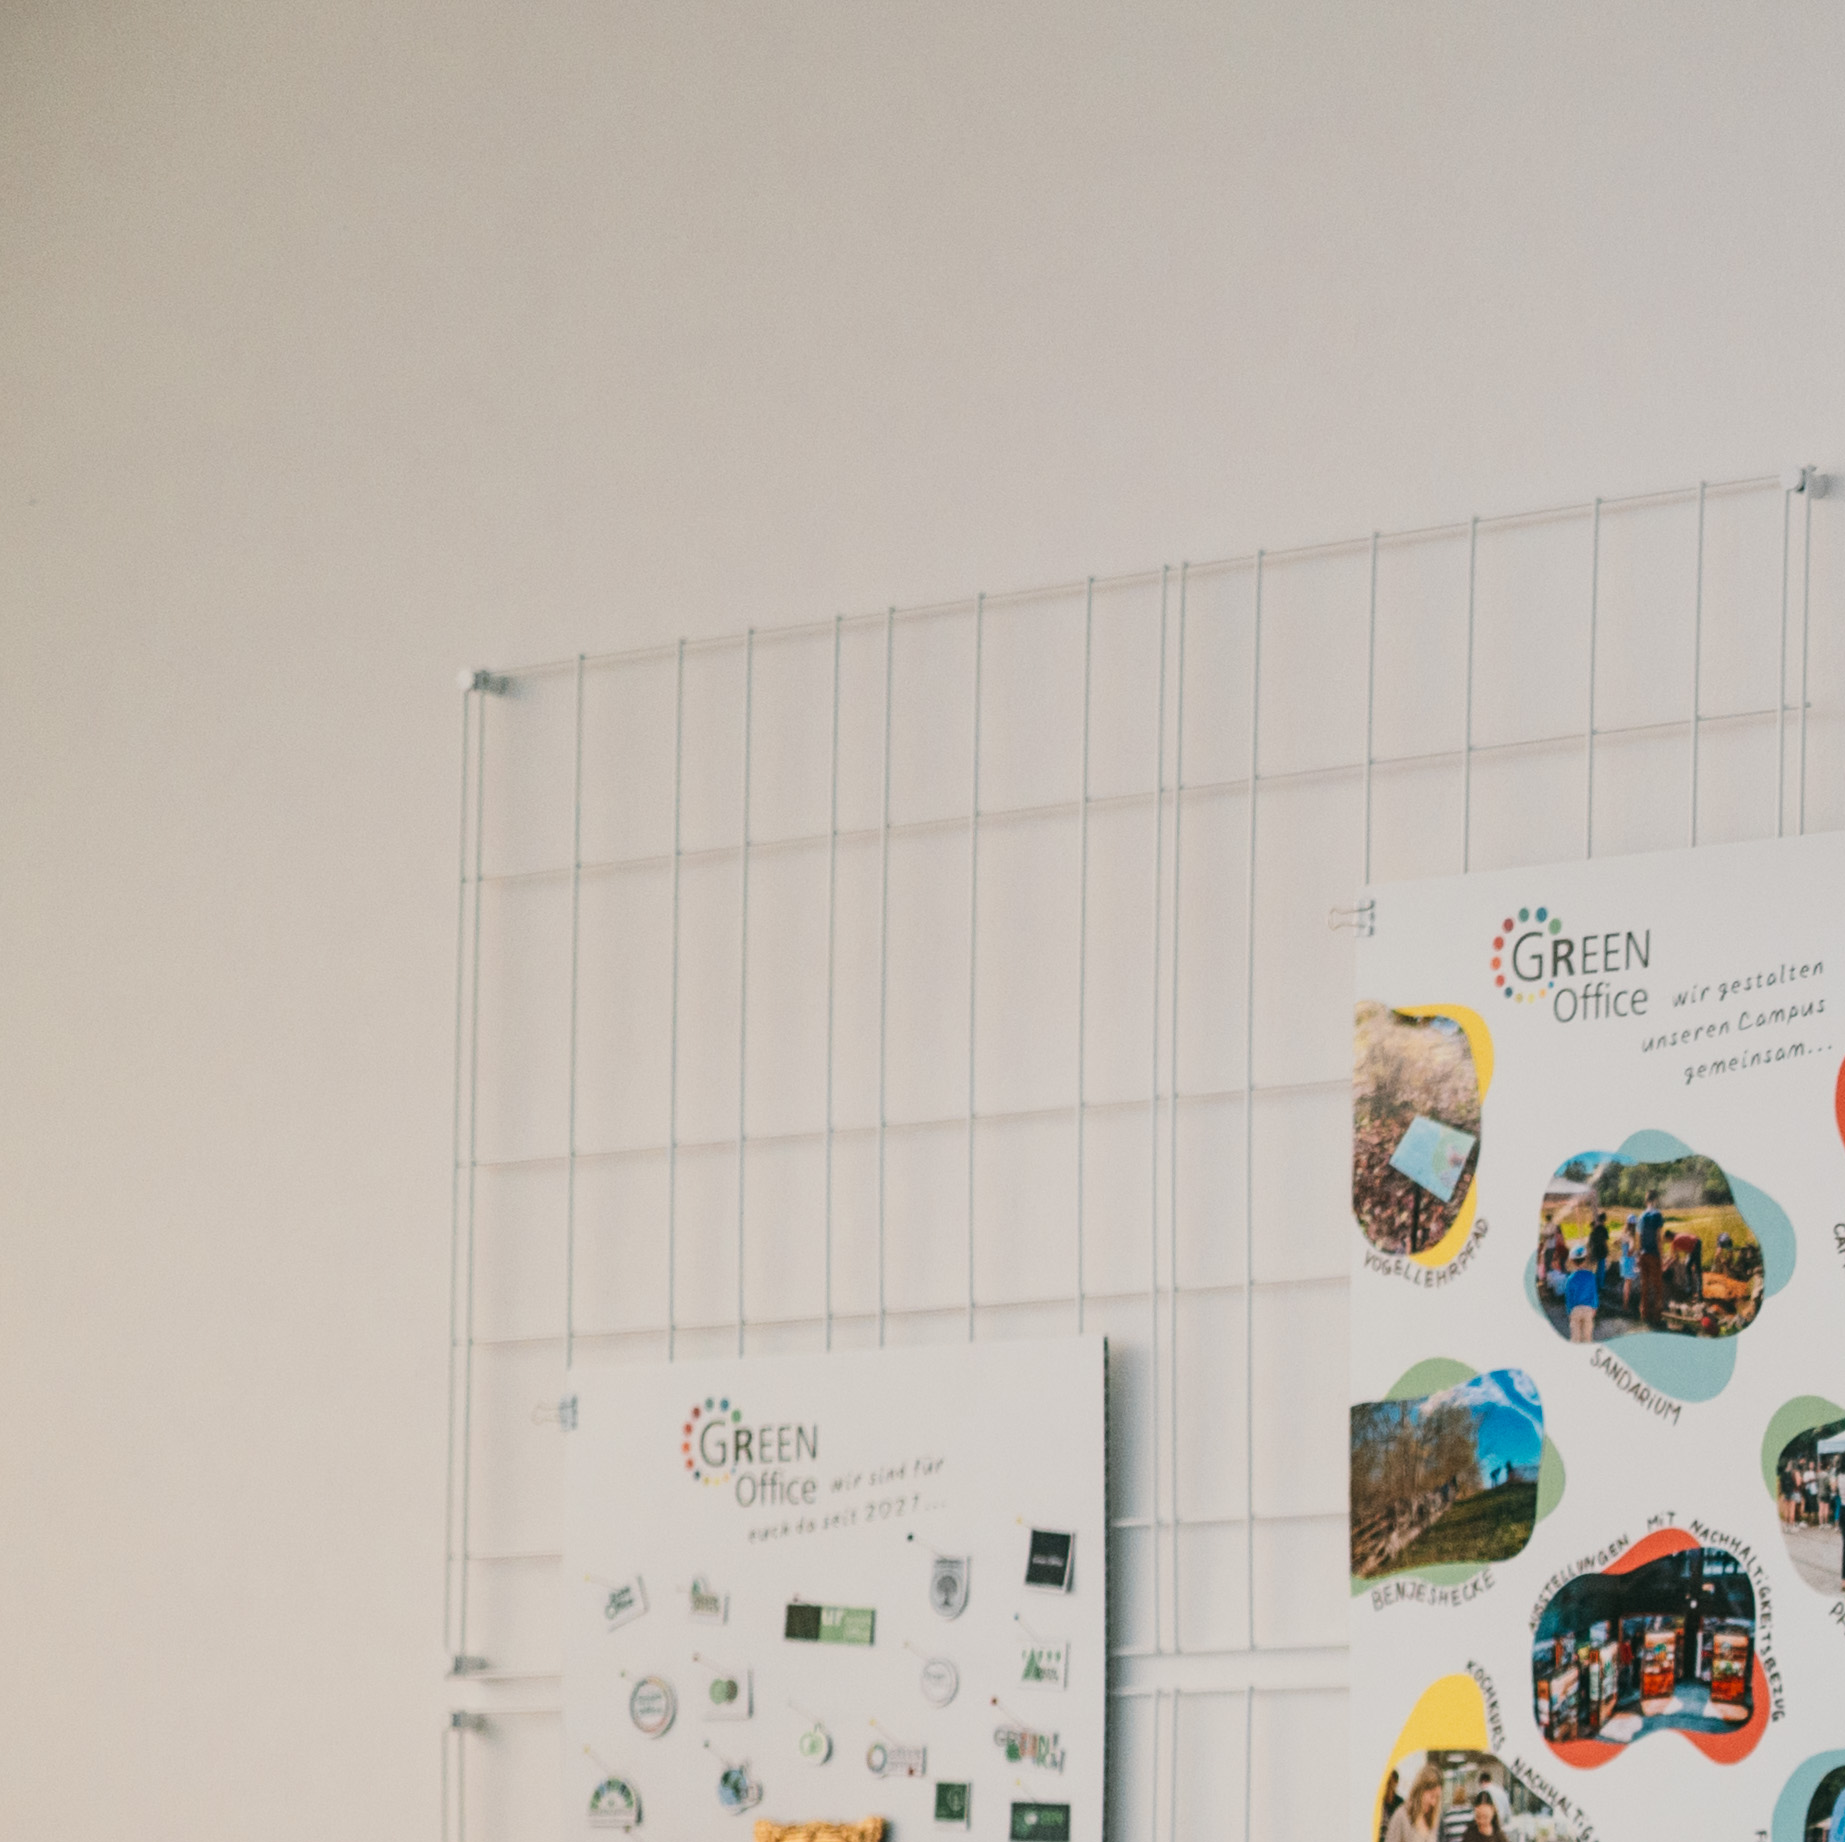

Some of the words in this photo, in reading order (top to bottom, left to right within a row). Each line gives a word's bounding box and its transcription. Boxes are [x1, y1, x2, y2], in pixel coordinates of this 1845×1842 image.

[1512, 929, 1652, 983] GREEN
[1553, 983, 1649, 1024] Office
[1673, 983, 1711, 1008] wir
[1718, 961, 1824, 1002] gestalten
[1641, 1021, 1730, 1053] unseren
[1737, 997, 1827, 1032] Campus
[1363, 1216, 1489, 1289] VOGELLEHRPFAD
[700, 1420, 818, 1468] GREEN
[735, 1471, 816, 1508] Office
[1370, 1567, 1497, 1612] BENJESHECKE
